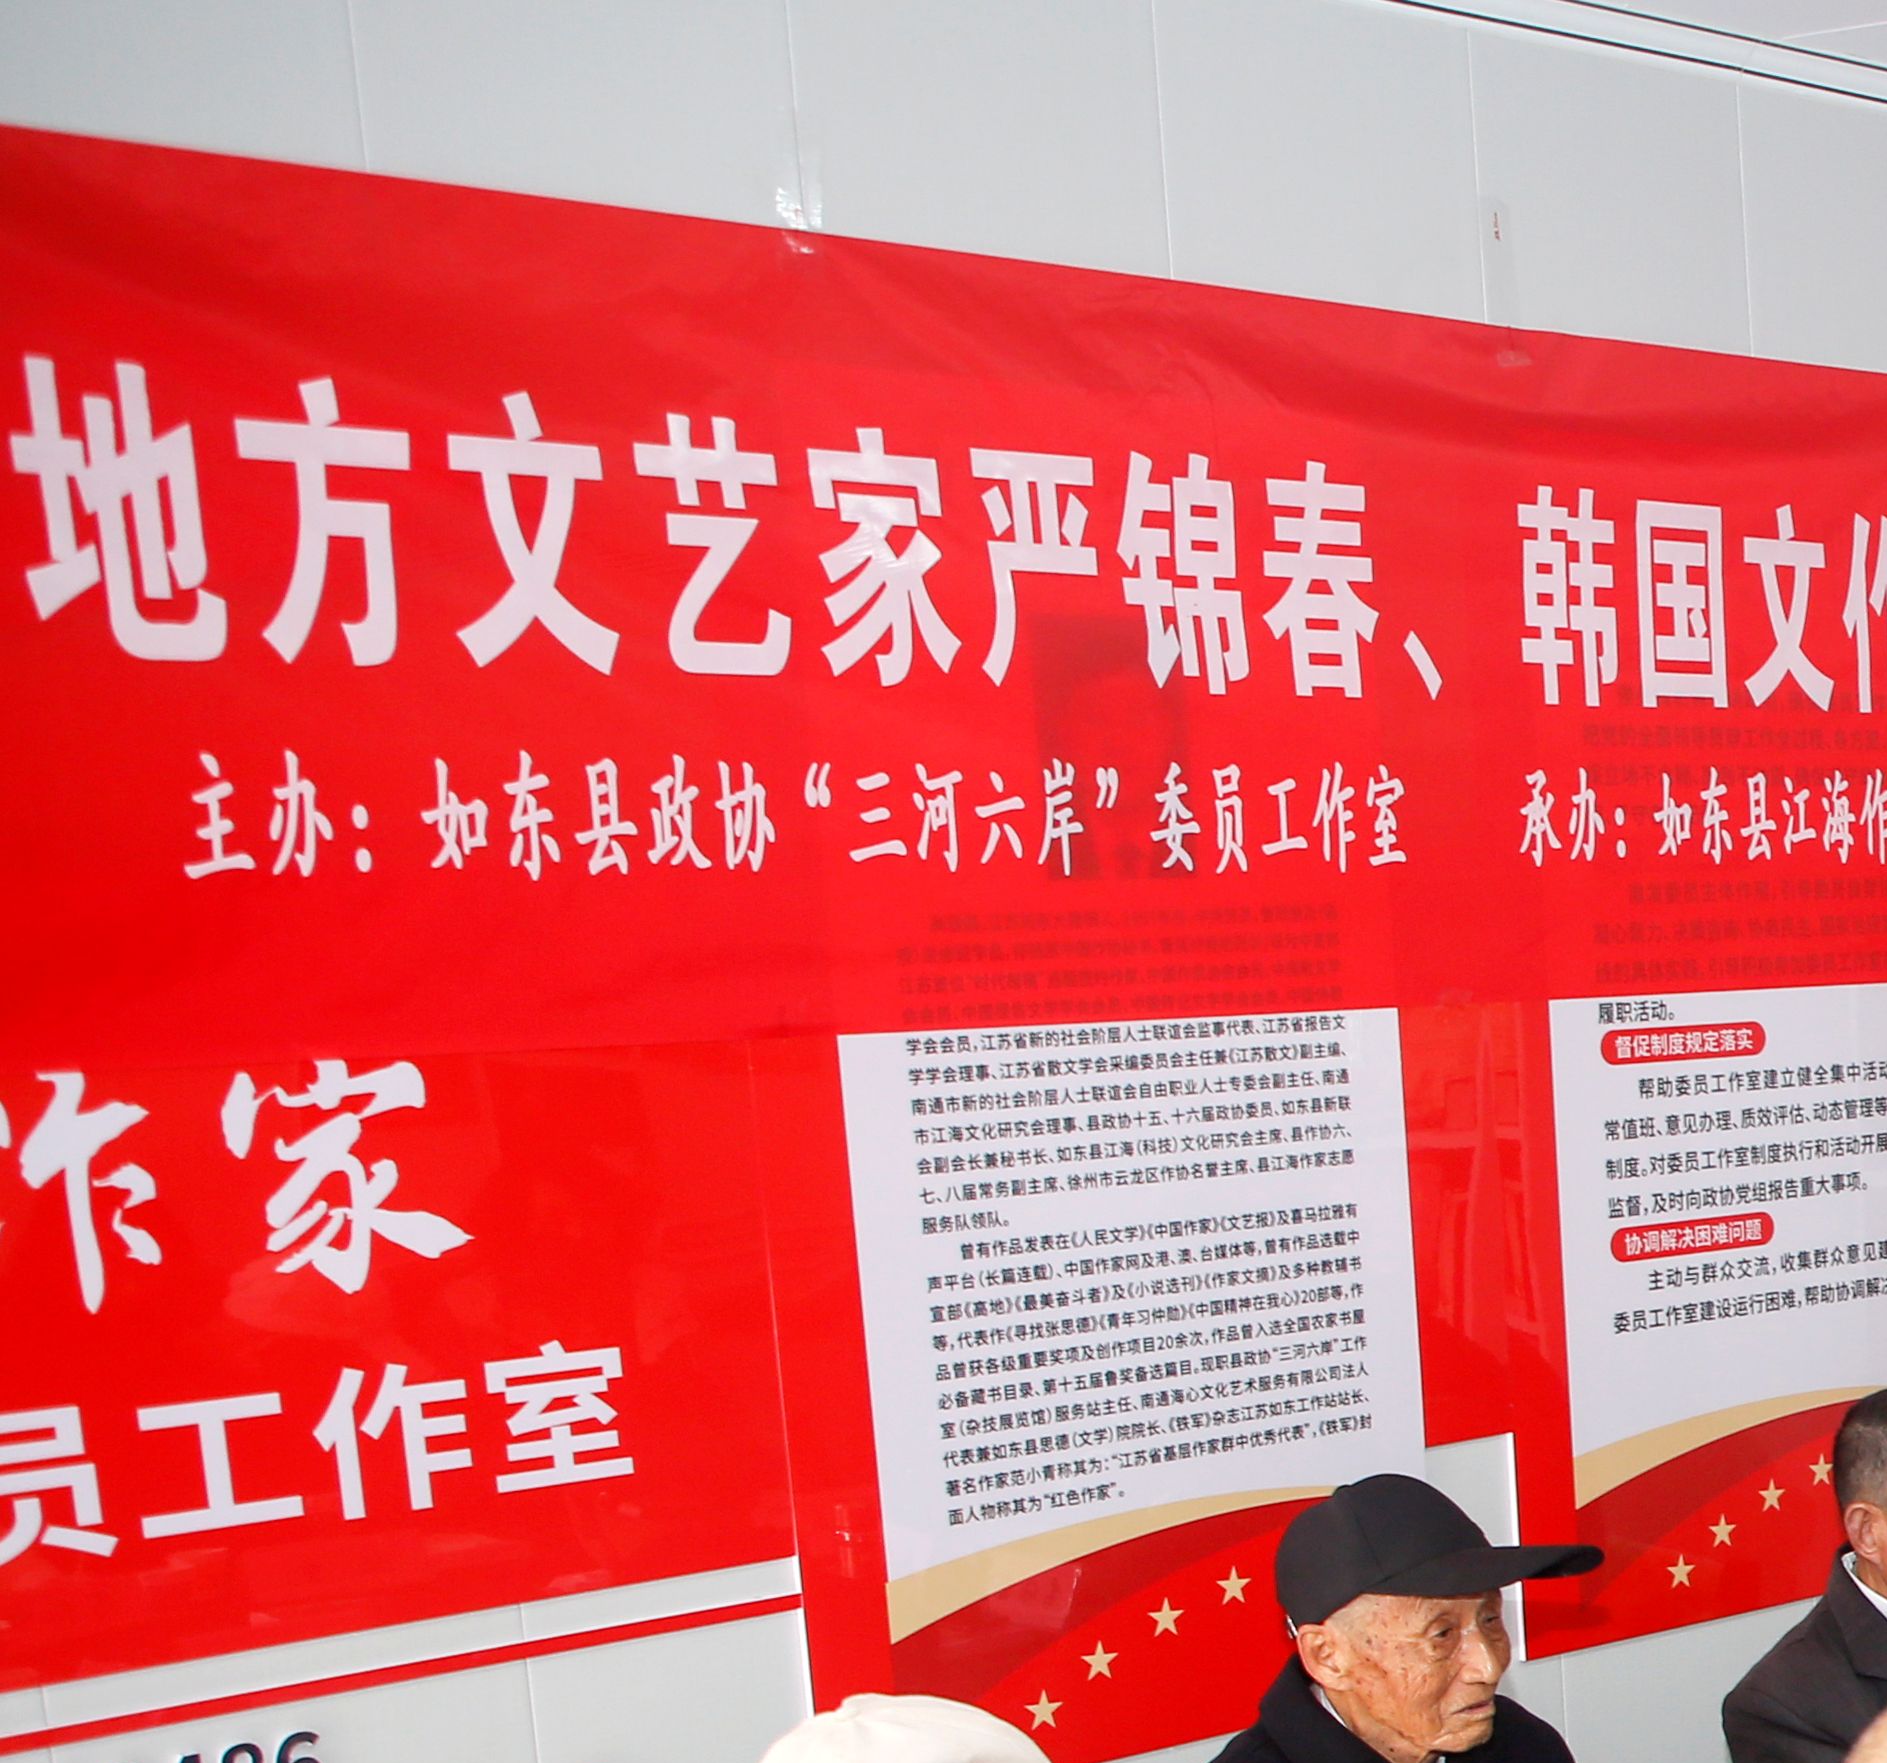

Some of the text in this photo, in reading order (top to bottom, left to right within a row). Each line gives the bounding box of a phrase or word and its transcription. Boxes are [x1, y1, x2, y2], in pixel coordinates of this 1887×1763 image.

[1615, 1027, 1754, 1059] 督促制度规定落实
[1624, 1217, 1763, 1256] 协调解决困难问题
